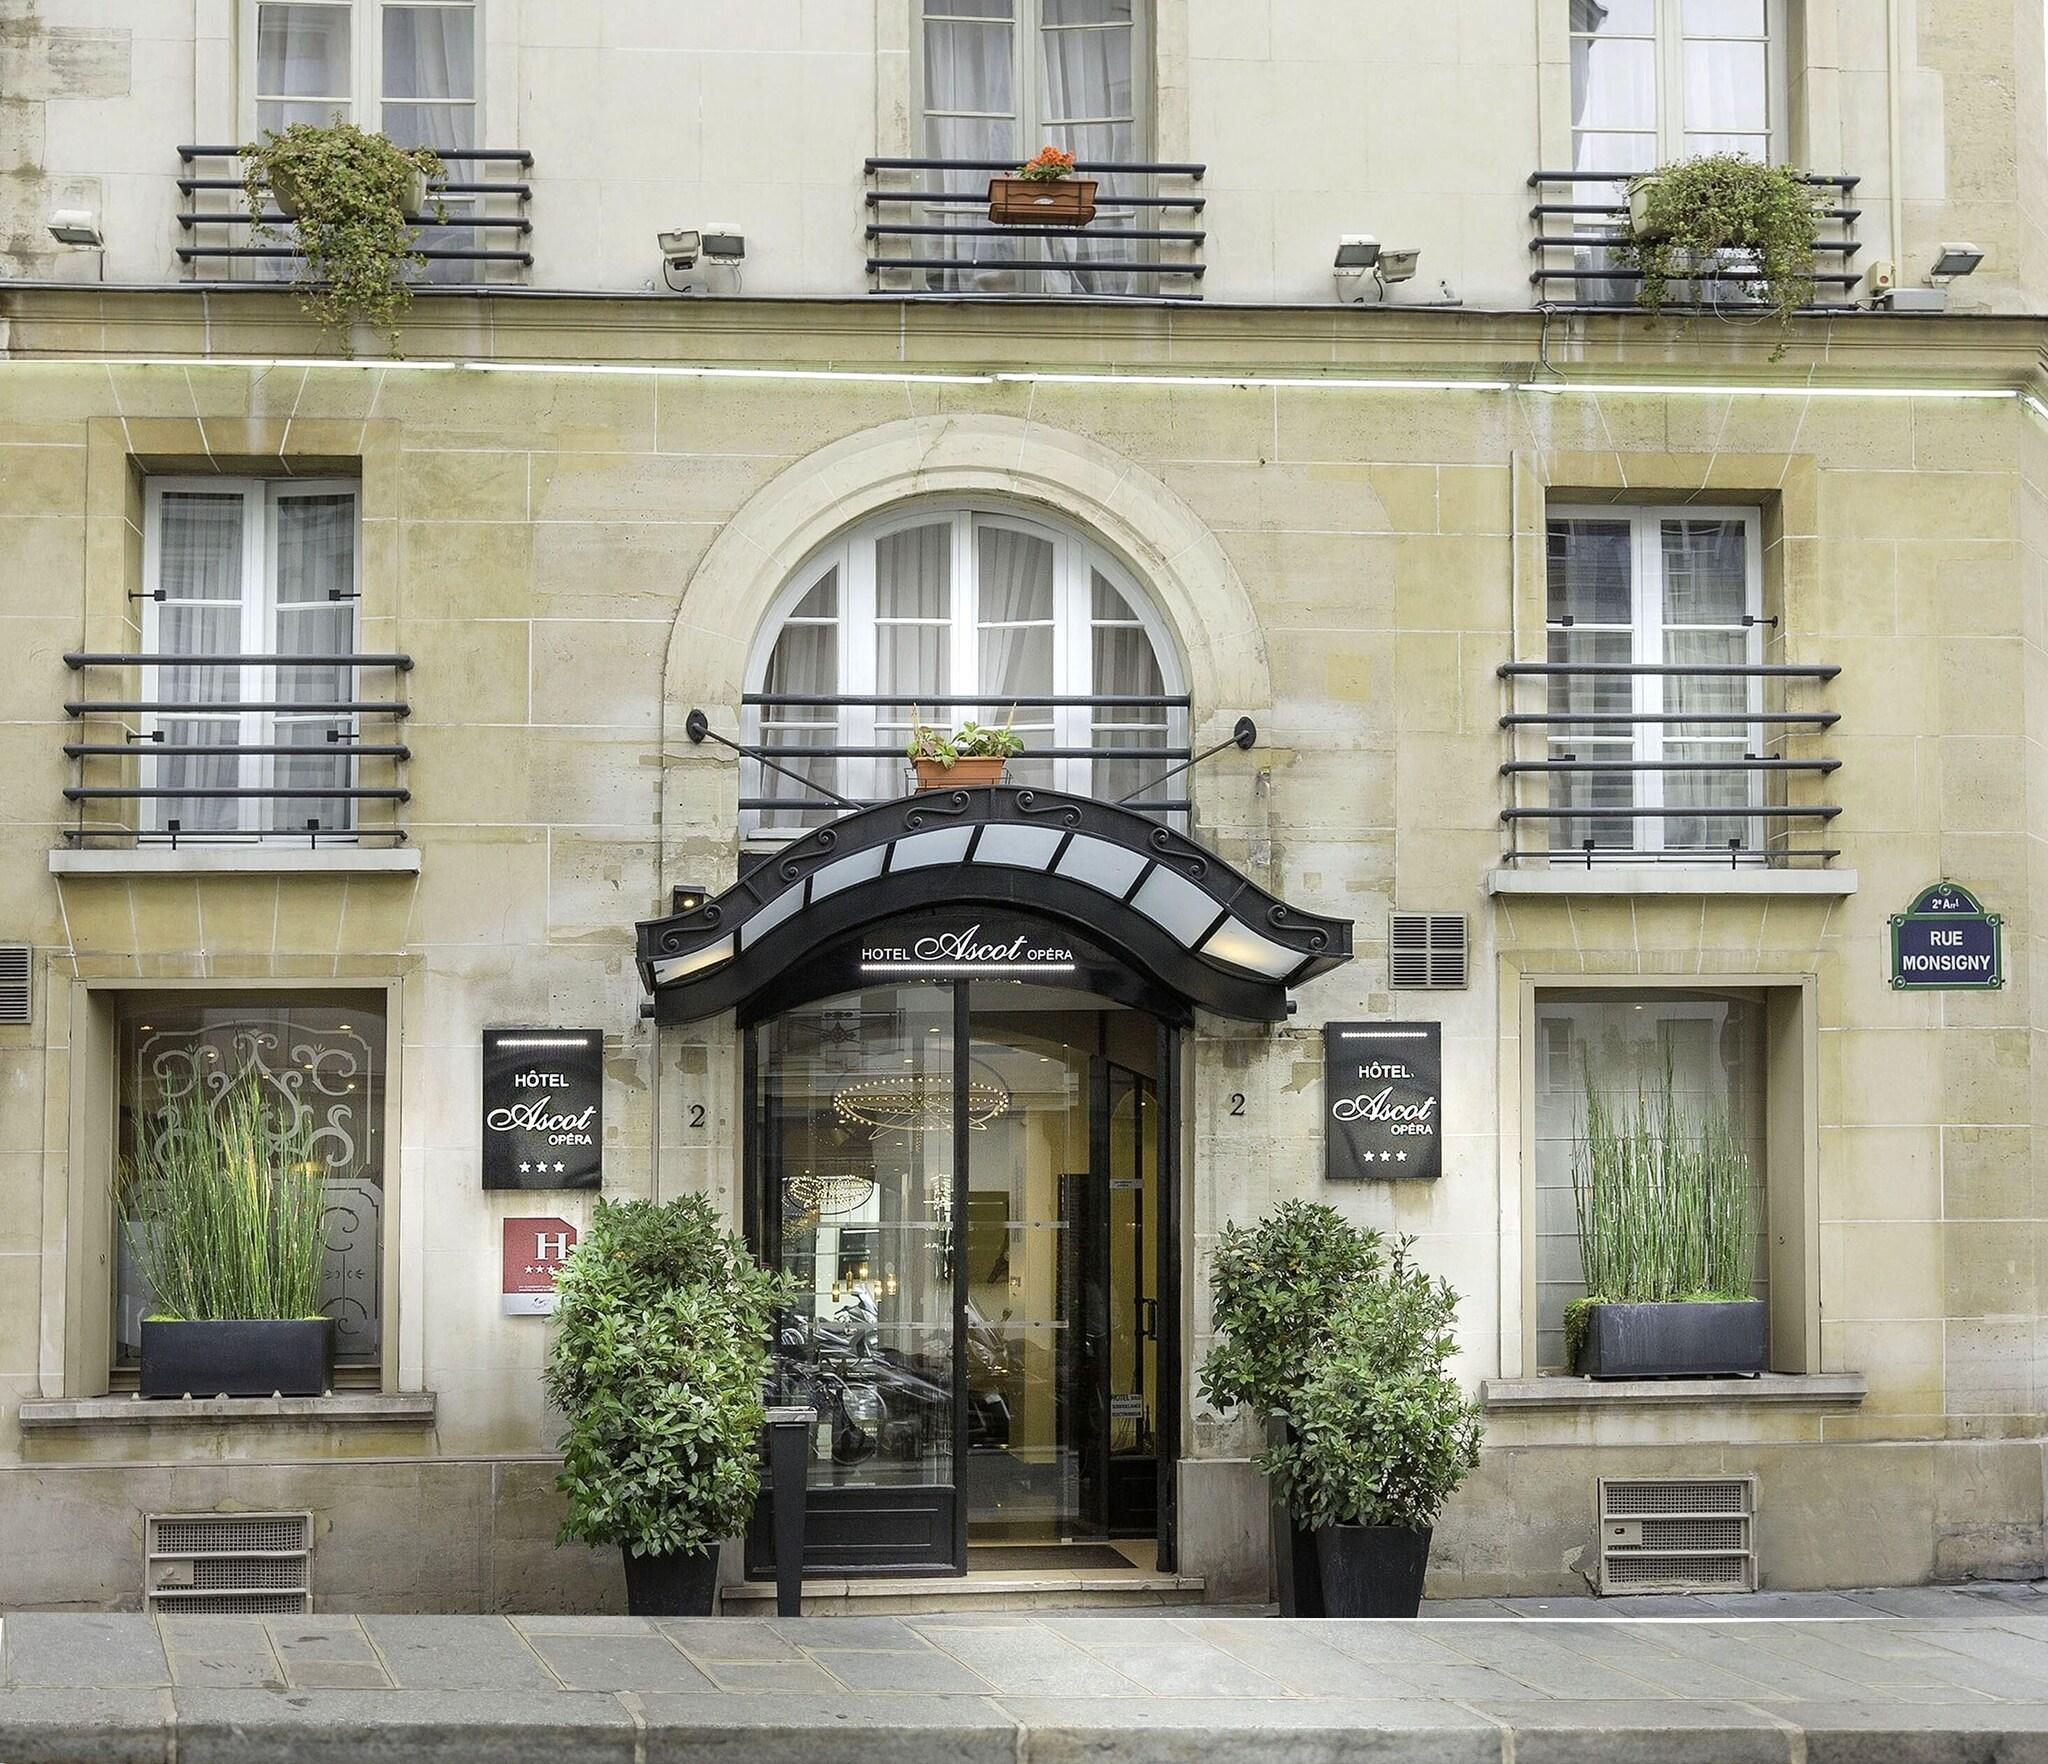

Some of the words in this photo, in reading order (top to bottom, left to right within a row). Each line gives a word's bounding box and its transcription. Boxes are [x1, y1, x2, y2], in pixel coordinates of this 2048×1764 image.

[861, 948, 910, 961] HOTEL
[914, 923, 1028, 962] Ascot
[1027, 947, 1073, 961] OPÉRA
[1930, 930, 1963, 946] RUE
[1903, 955, 1991, 971] MONSIGNY
[514, 1070, 569, 1088] HÔTEL
[1358, 1060, 1410, 1079] HÔTEL
[487, 1095, 597, 1131] Ascot
[1229, 1093, 1246, 1116] 2
[1332, 1086, 1437, 1122] Ascot
[688, 1104, 705, 1128] 2
[548, 1132, 592, 1146] OPÉRA
[1390, 1123, 1433, 1136] OPÉRA
[534, 1232, 570, 1260] H
